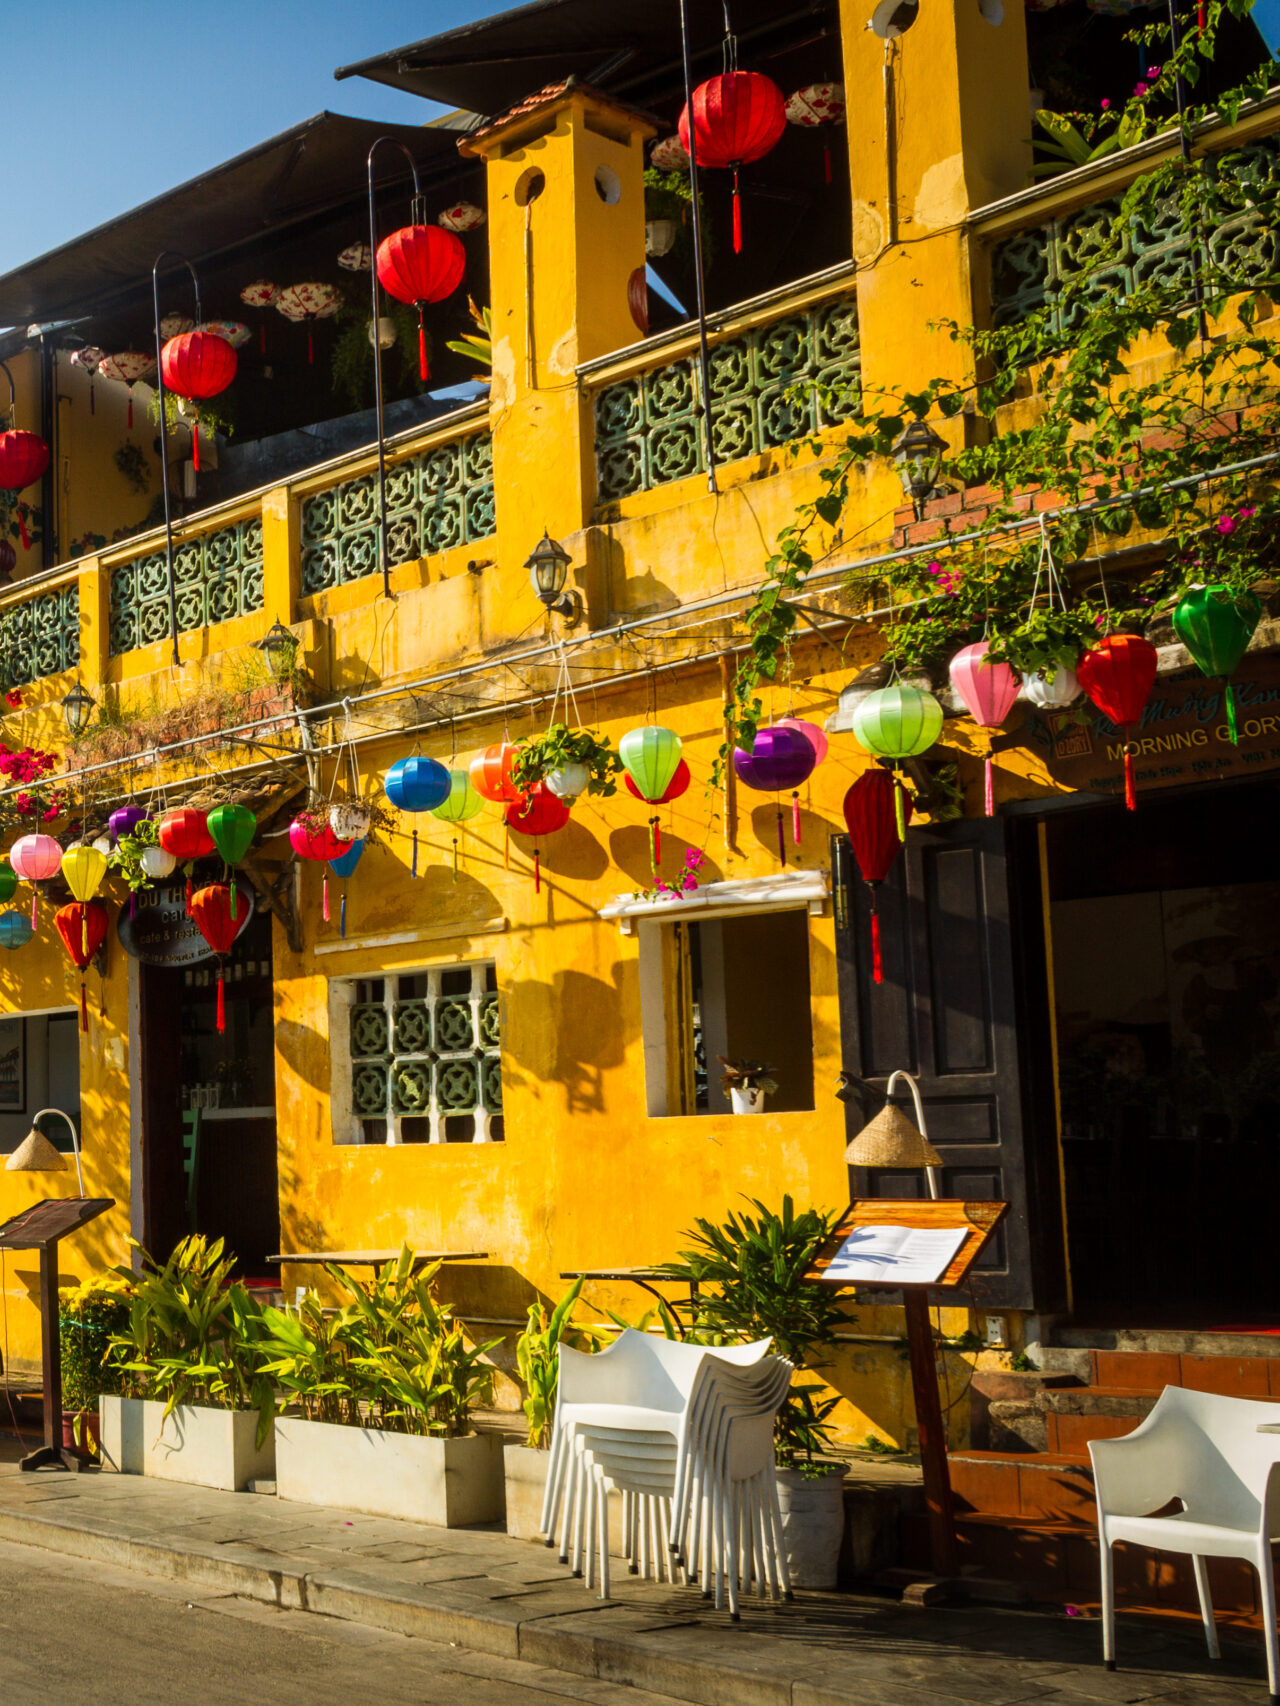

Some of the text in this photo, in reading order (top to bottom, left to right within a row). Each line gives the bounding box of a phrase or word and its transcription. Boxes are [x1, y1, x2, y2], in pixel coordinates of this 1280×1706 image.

[1232, 682, 1280, 707] Xan
[1106, 728, 1209, 761] MORNING
[138, 889, 159, 909] DU
[162, 909, 195, 924] carg
[175, 927, 203, 940] resta
